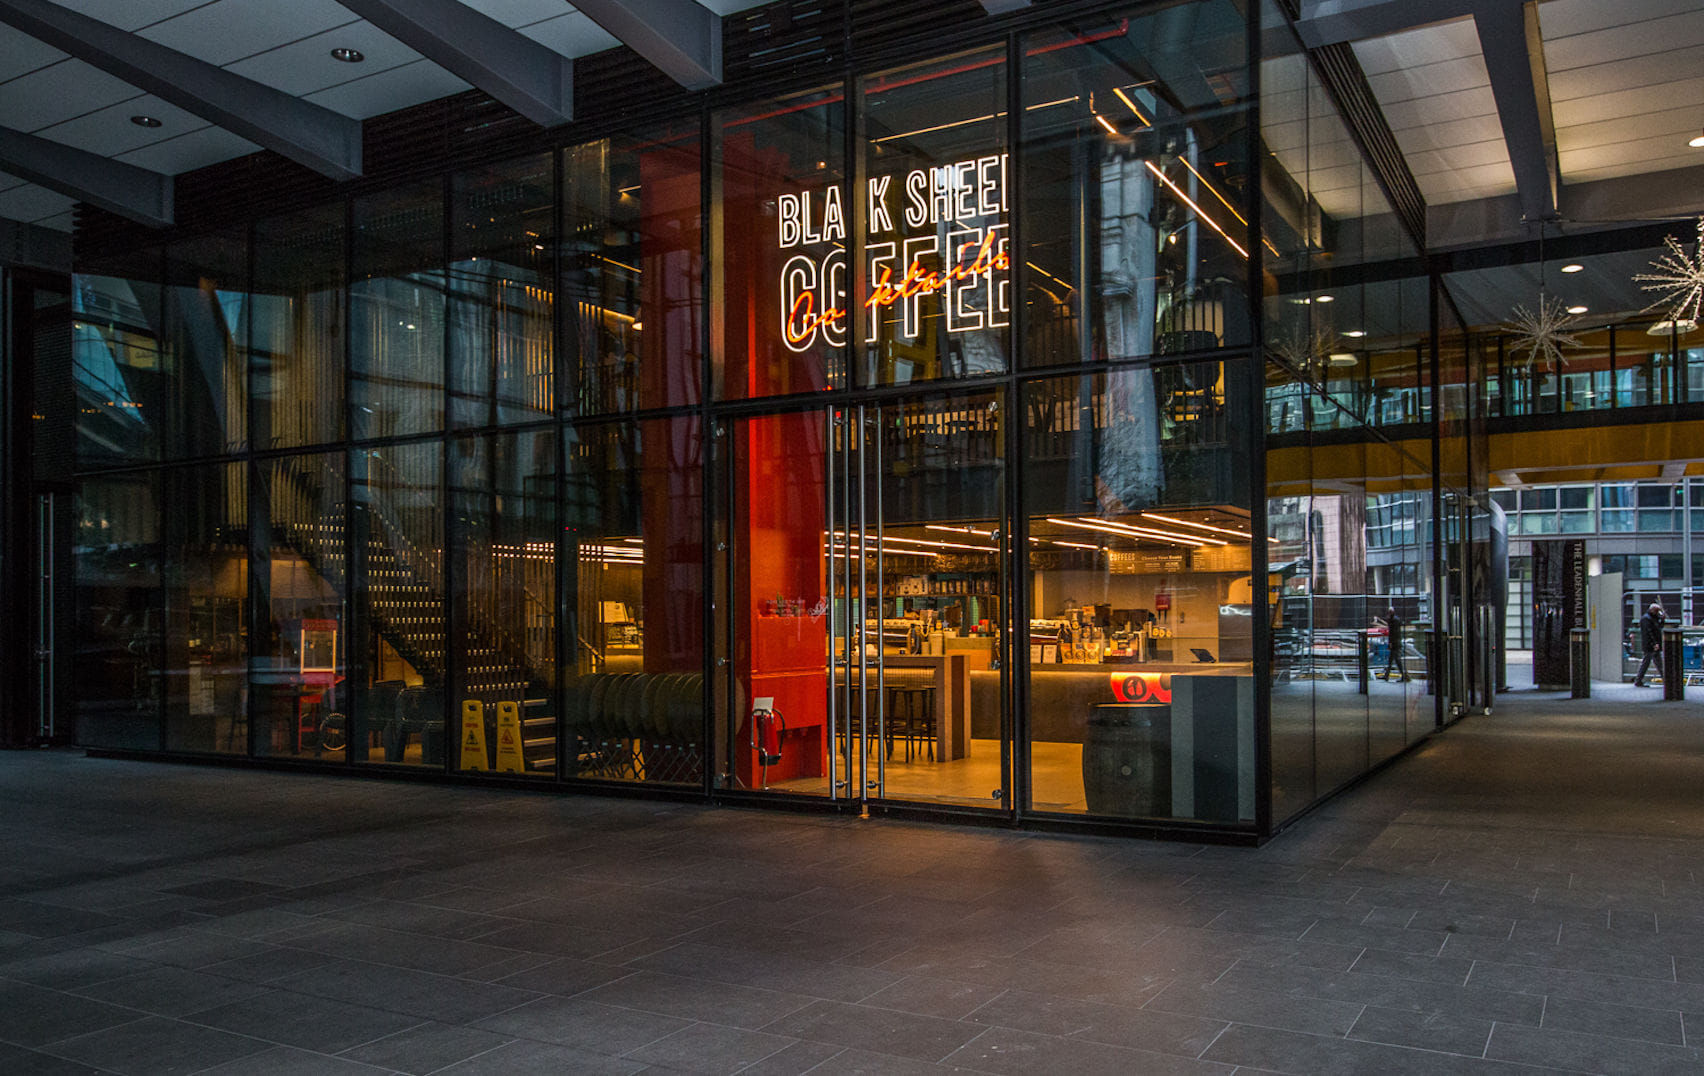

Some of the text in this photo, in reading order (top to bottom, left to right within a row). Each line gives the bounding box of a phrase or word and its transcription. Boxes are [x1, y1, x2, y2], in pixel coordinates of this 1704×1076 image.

[778, 154, 1010, 249] BLAK SHEE
[786, 230, 1010, 343] Coktails
[1574, 542, 1582, 560] THE
[1574, 561, 1583, 615] LEADENHALL
